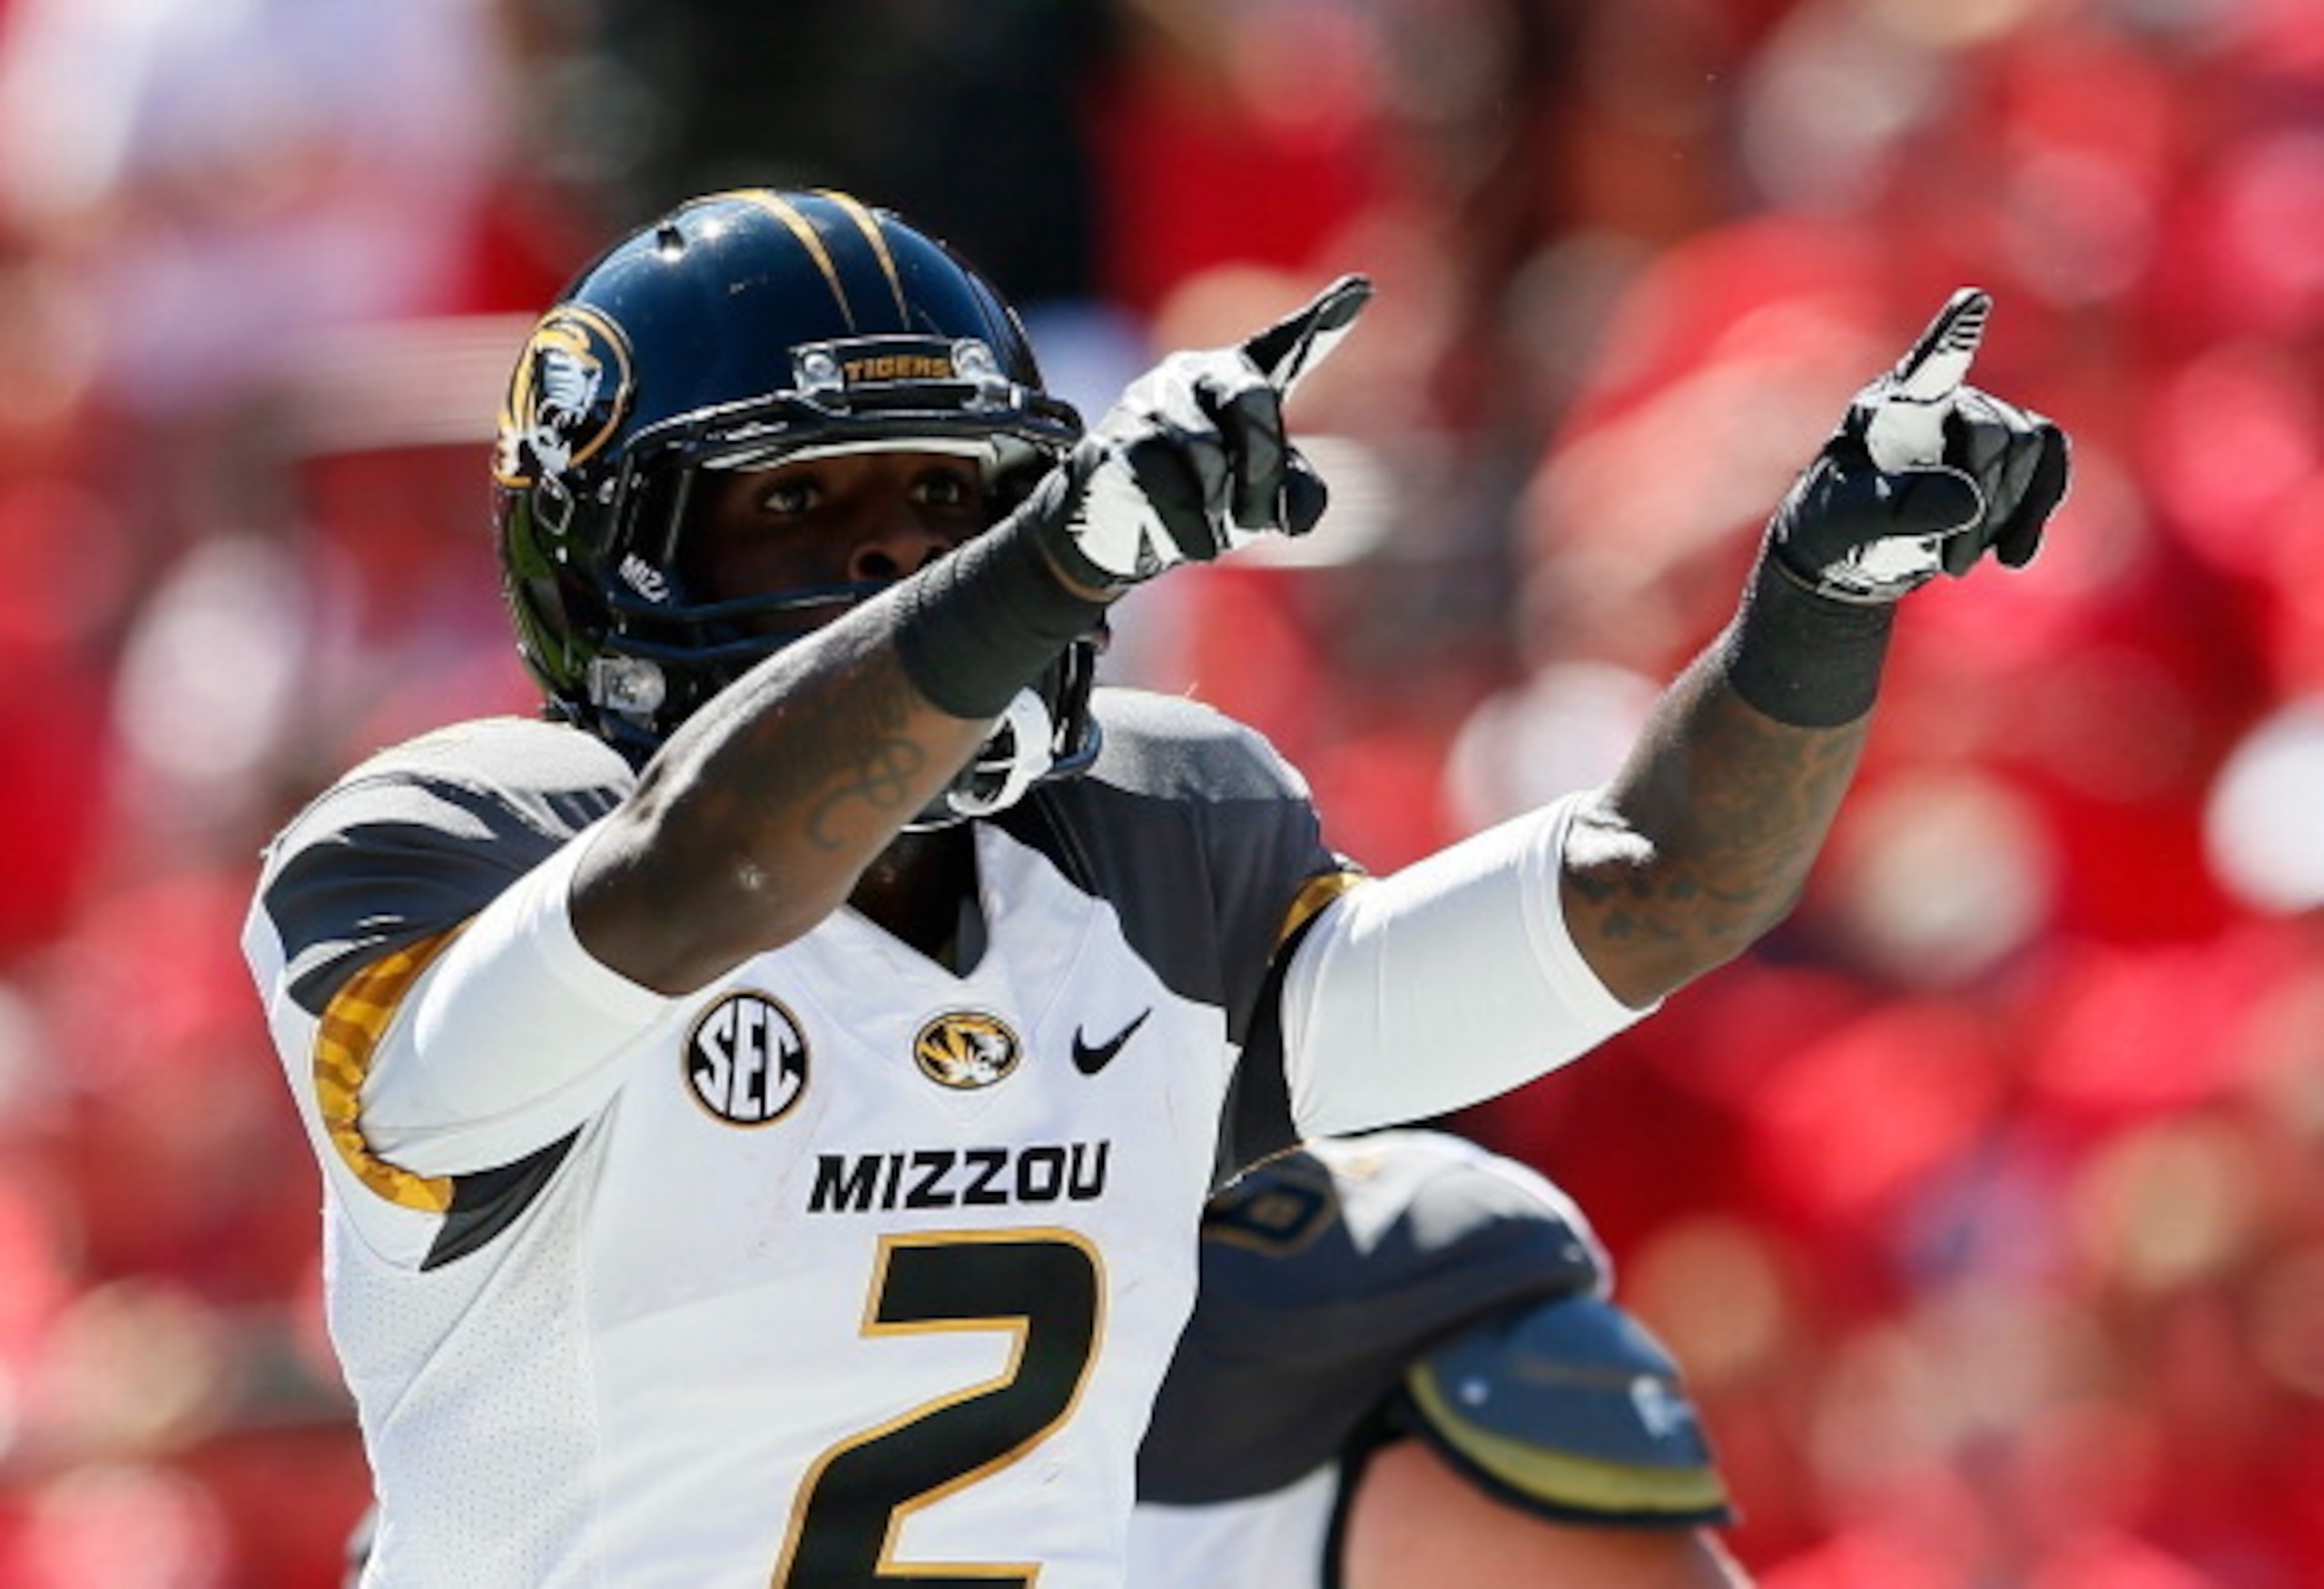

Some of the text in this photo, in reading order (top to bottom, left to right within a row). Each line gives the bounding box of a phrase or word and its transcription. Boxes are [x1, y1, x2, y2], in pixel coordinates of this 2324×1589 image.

[844, 355, 951, 380] TIGERS
[694, 997, 803, 1119] SEC
[808, 1142, 1110, 1213] MIZZOU
[771, 1226, 1107, 1589] 2
